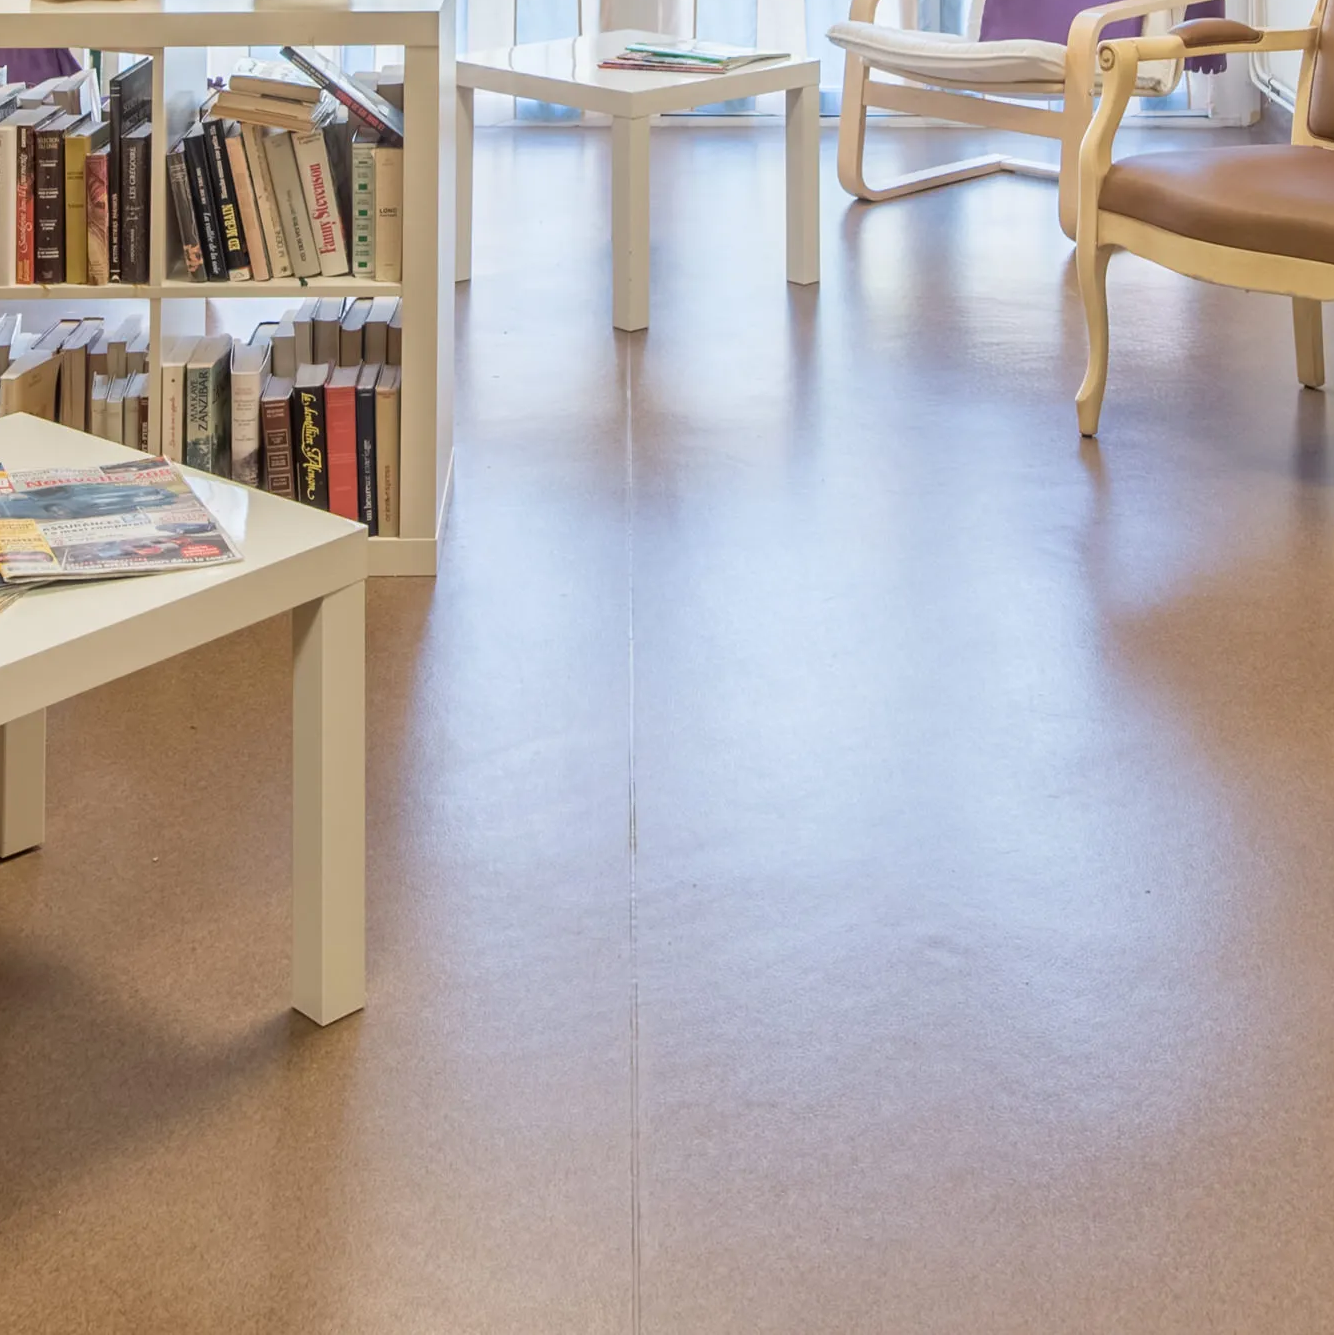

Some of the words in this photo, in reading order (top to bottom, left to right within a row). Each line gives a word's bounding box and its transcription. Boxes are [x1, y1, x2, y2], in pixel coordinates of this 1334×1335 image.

[309, 163, 331, 219] Stevenson
[203, 212, 212, 222] La
[221, 203, 238, 238] McBAIN
[204, 222, 215, 243] vallée
[320, 221, 337, 255] Fanny
[208, 243, 216, 252] de
[229, 238, 240, 251] ED
[210, 252, 217, 260] la
[190, 379, 198, 401] KAYE
[198, 371, 208, 431] ZANZIBAR
[362, 440, 371, 473] mariage
[26, 474, 127, 489] Nouvelle
[366, 510, 372, 521] un
[42, 519, 121, 532] ASSURANCES
